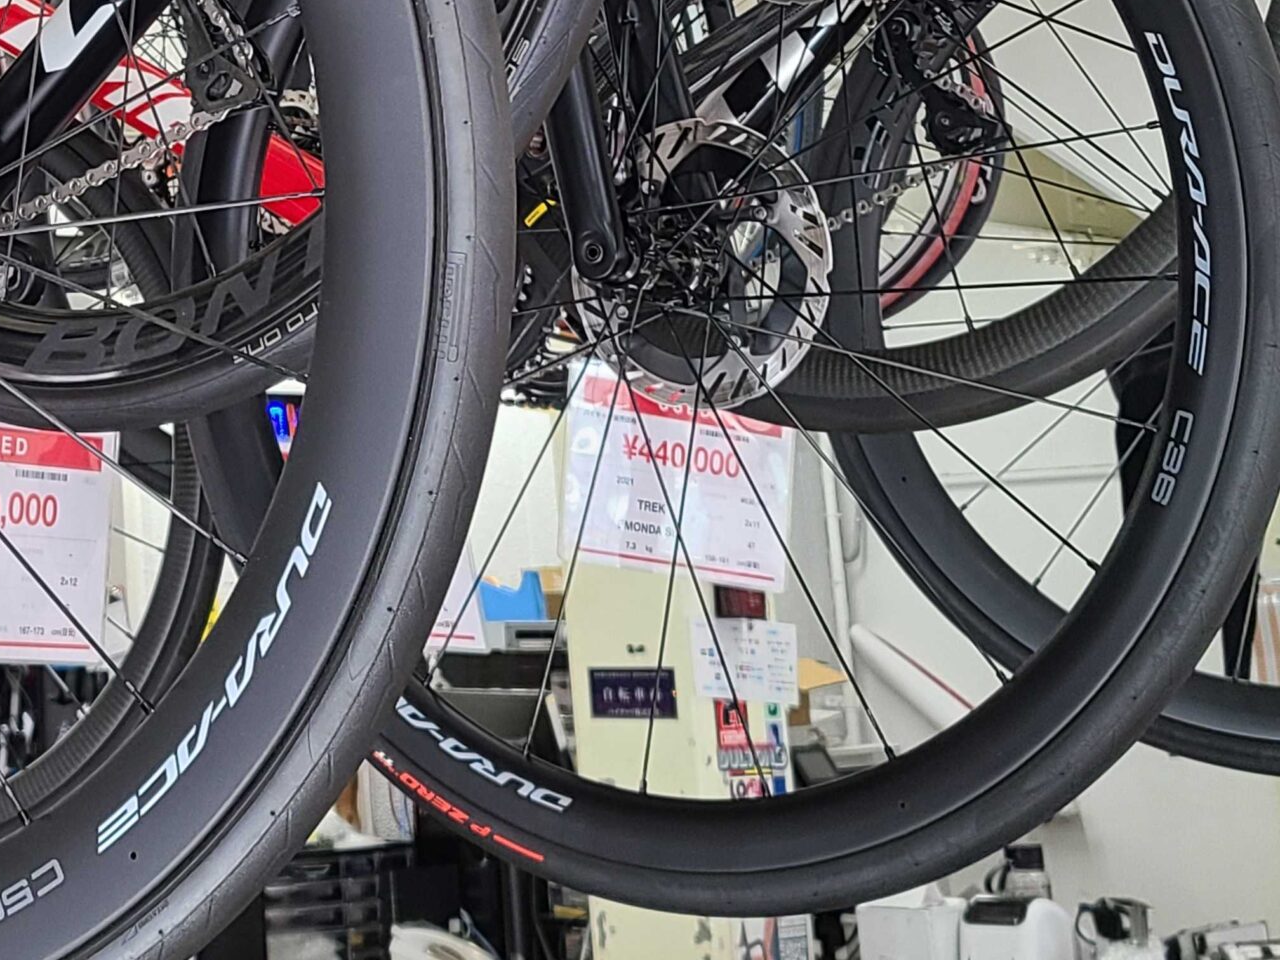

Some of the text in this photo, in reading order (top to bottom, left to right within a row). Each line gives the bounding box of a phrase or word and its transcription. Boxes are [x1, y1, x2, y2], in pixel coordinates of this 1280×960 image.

[1144, 31, 1211, 507] DURA-ACE C36
[623, 432, 740, 480] ¥440000
[617, 519, 662, 536] MONDA
[638, 498, 666, 515] TREK
[98, 482, 332, 854] DURA-ACE
[399, 772, 492, 839] P ZERO
